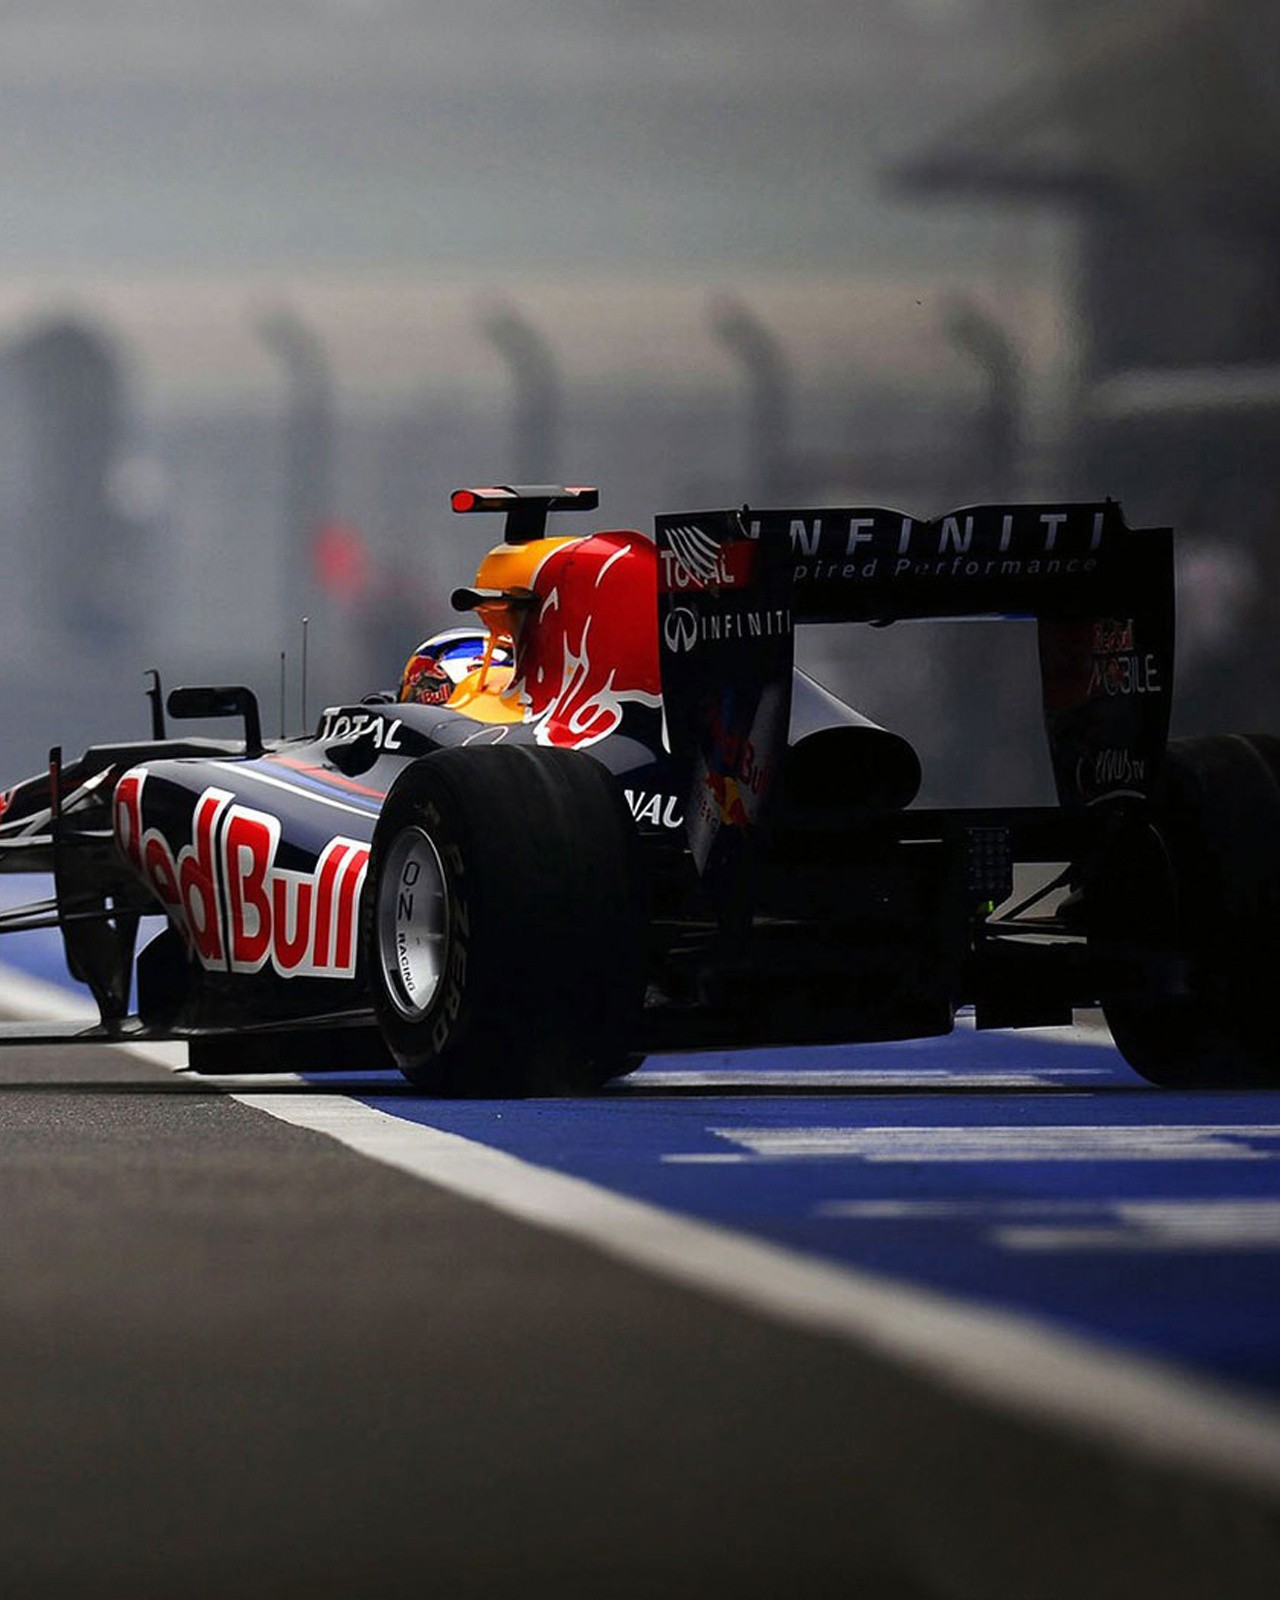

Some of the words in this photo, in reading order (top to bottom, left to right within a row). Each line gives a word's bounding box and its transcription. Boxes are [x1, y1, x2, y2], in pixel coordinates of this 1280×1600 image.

[659, 549, 736, 588] TOAL
[701, 609, 791, 640] INFINITI
[315, 706, 404, 750] TOTAL
[224, 810, 370, 972] Bull
[397, 932, 417, 993] RACING
